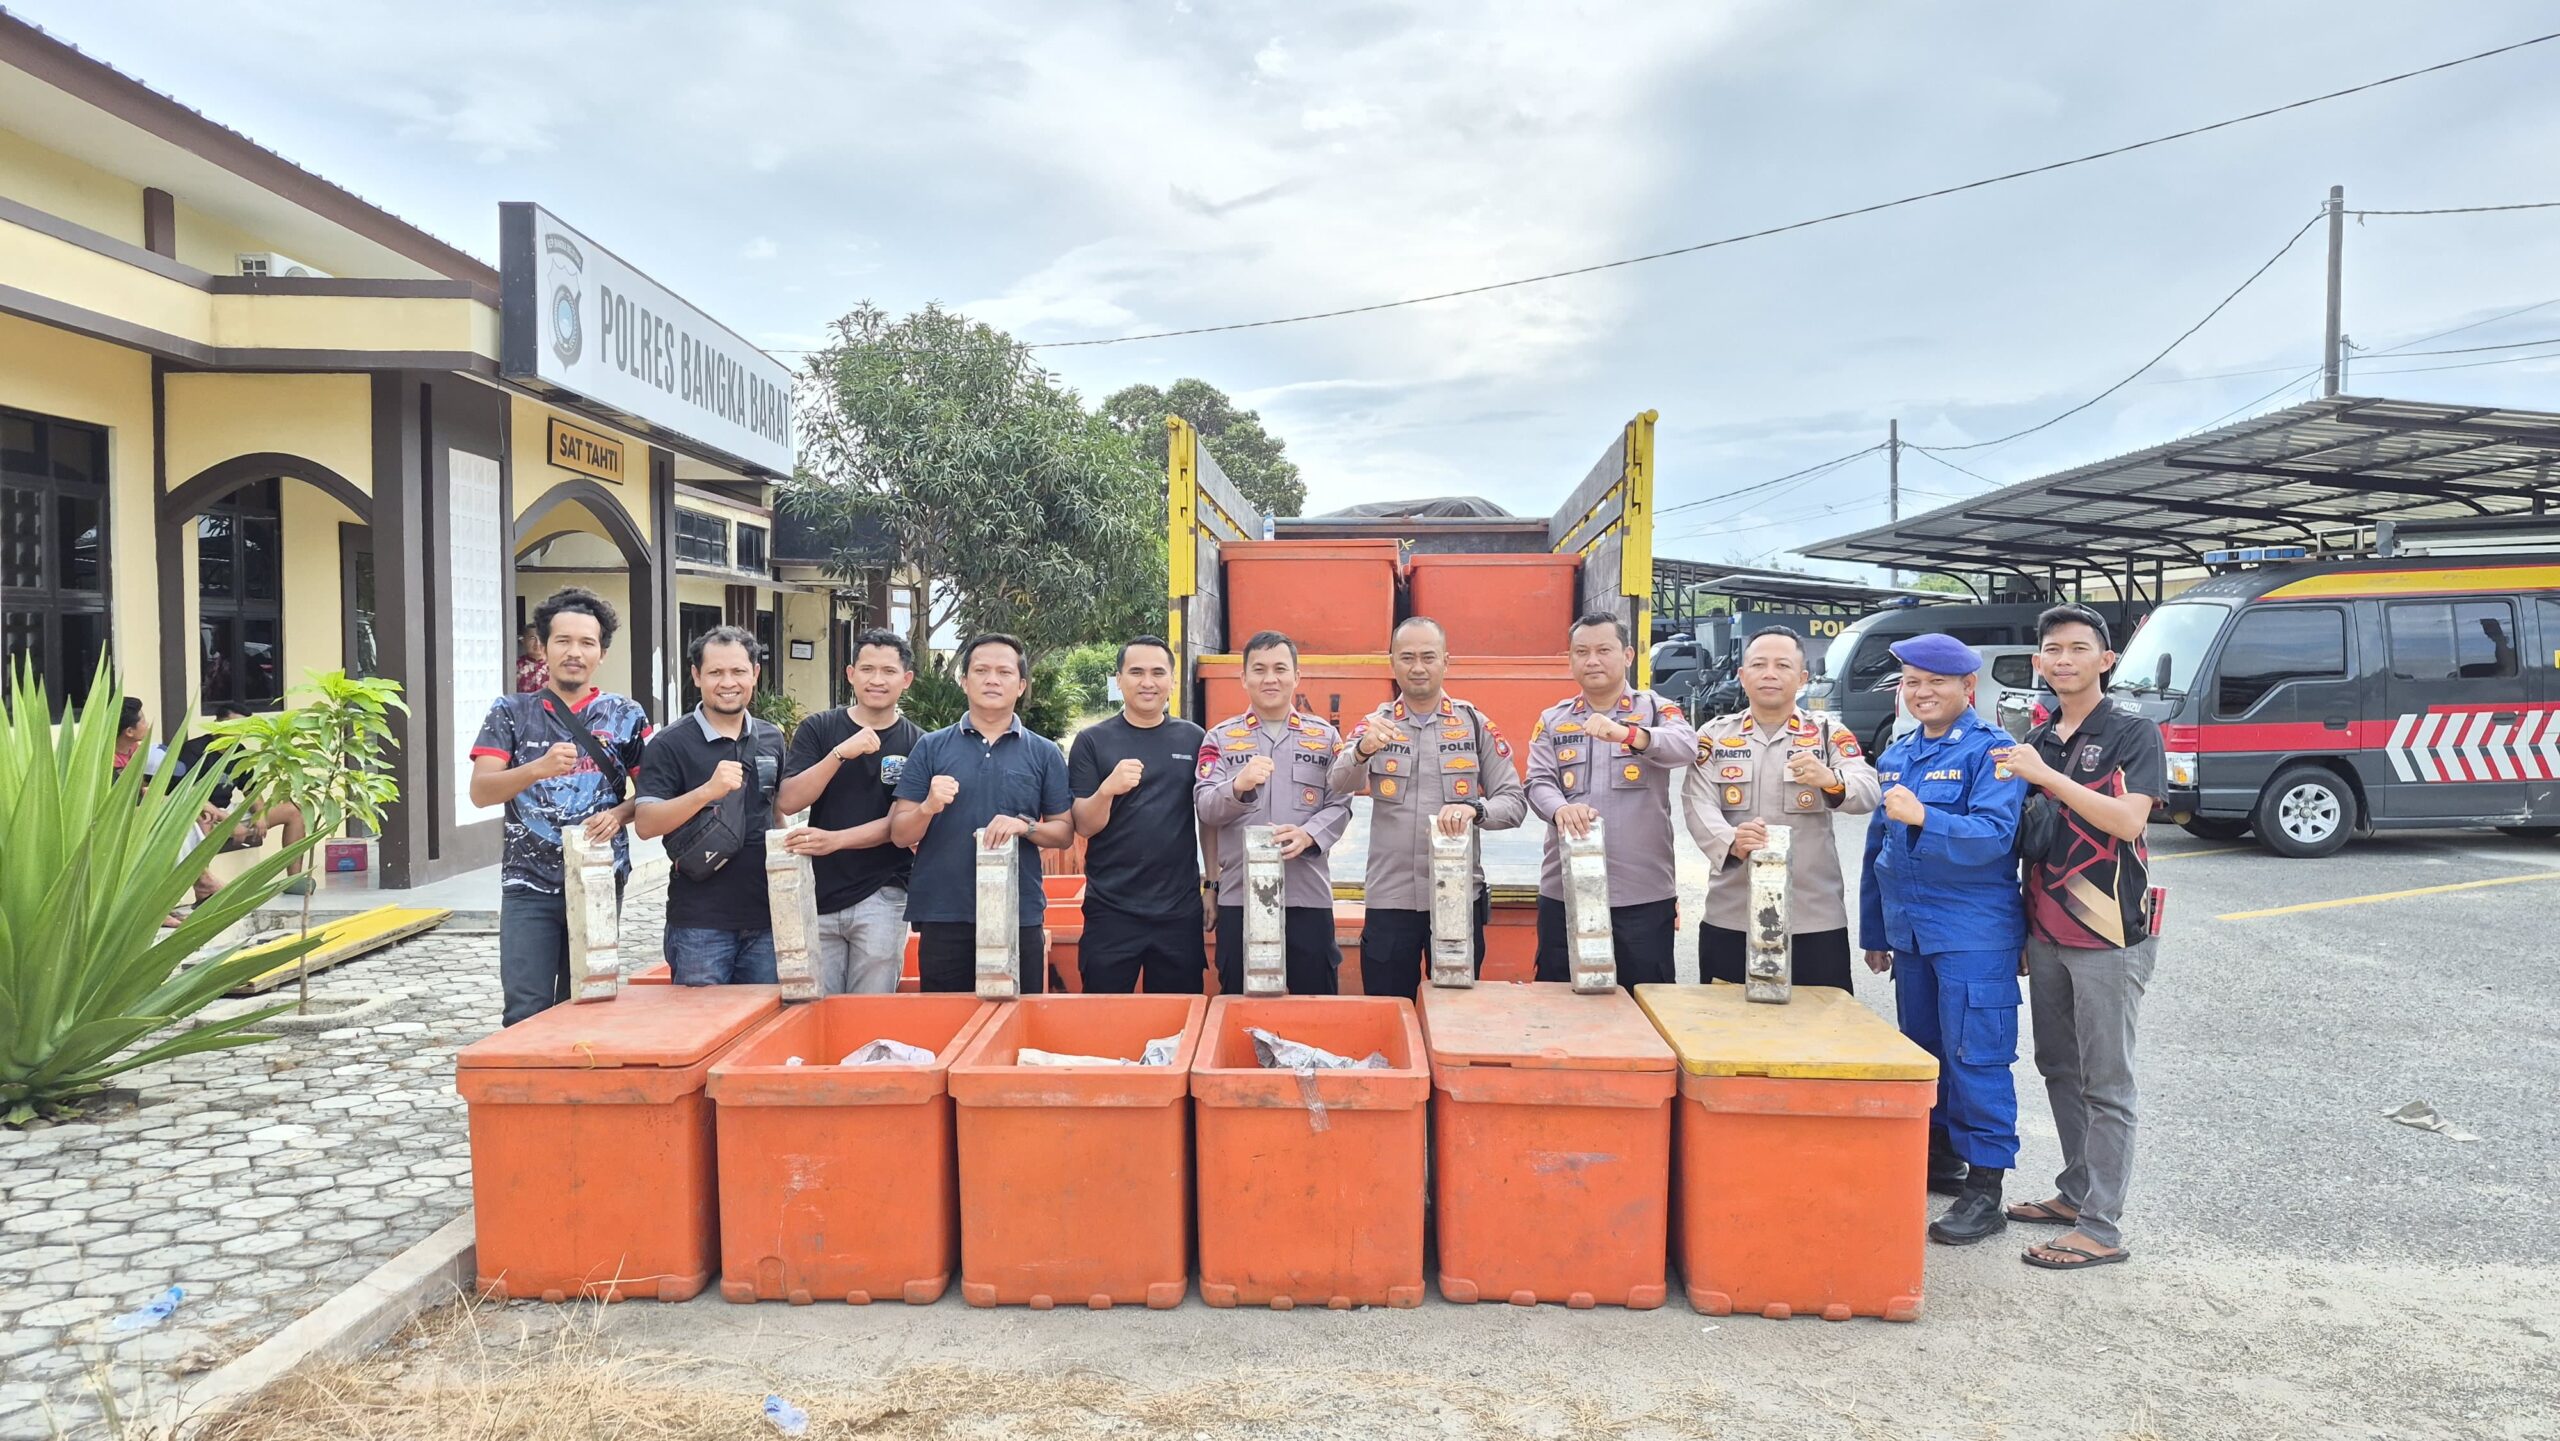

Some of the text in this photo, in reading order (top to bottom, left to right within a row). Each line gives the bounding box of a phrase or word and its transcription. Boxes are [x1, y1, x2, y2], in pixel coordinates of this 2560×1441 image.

[601, 284, 789, 449] POLRES BANGKA BARAT
[559, 433, 618, 473] SAT TAHTI
[2119, 701, 2142, 712] ISUZU
[1553, 734, 1585, 745] ALBERT
[1439, 741, 1475, 753] POLRI
[1295, 753, 1329, 766] POLRI
[1924, 769, 1961, 780] POLRI
